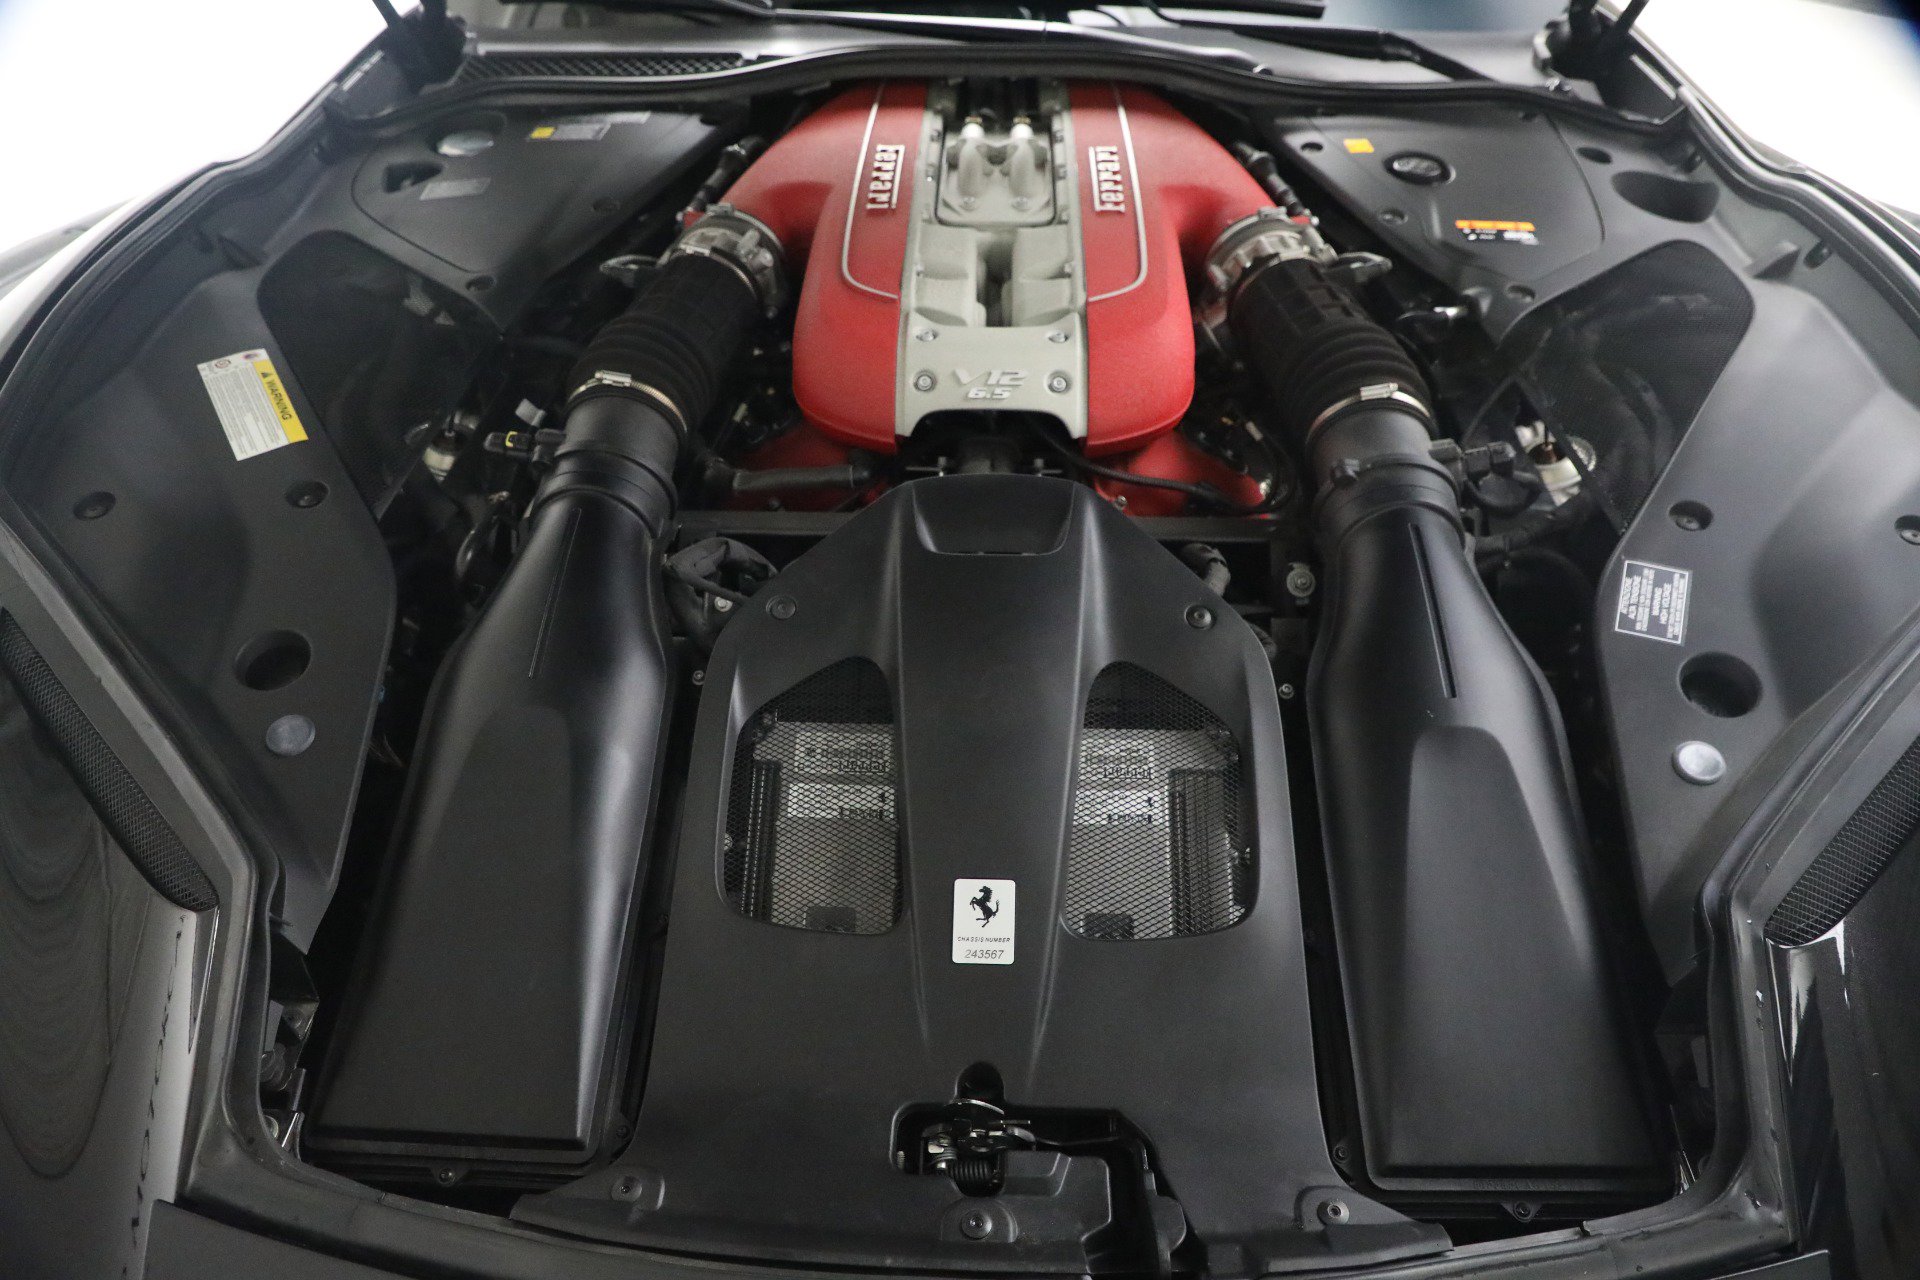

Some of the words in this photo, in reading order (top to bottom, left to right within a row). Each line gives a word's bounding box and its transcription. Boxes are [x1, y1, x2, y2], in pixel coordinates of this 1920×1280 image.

[866, 144, 905, 210] Ferrari
[1088, 145, 1125, 213] Ferrari
[952, 368, 1029, 387] V12
[966, 386, 1013, 400] 6.5
[266, 378, 293, 421] WARNING
[964, 949, 1005, 960] 243567
